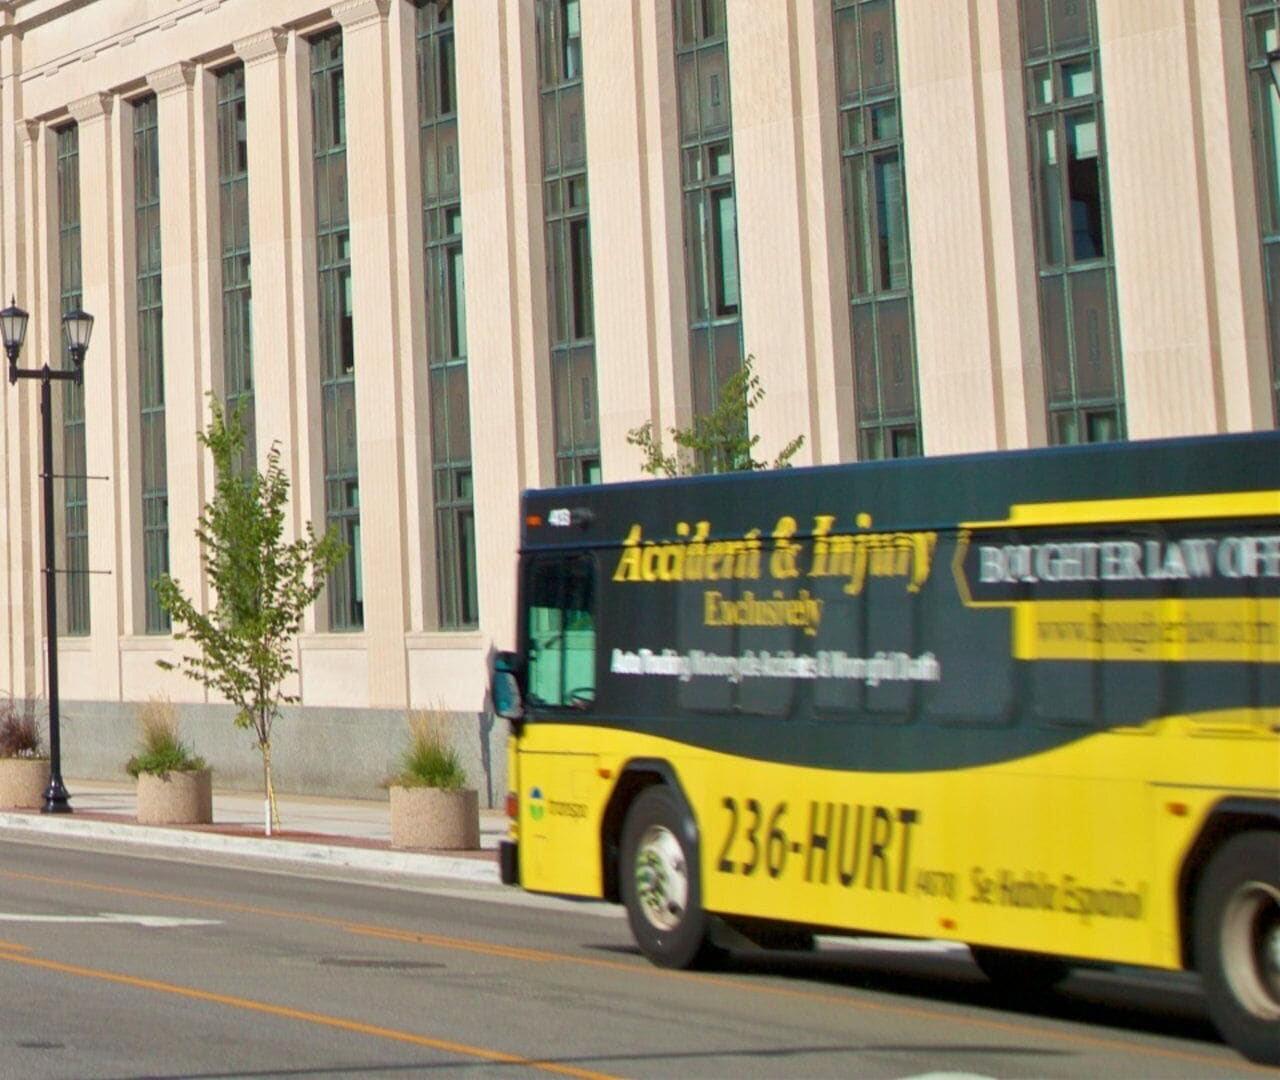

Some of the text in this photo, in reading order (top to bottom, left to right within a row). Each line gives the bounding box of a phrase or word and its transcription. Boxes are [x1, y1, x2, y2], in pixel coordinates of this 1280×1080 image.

[612, 512, 938, 597] Accident & Injury
[1146, 539, 1217, 580] LAW
[703, 589, 825, 637] Exclusively
[718, 796, 920, 895] 236-HURT
